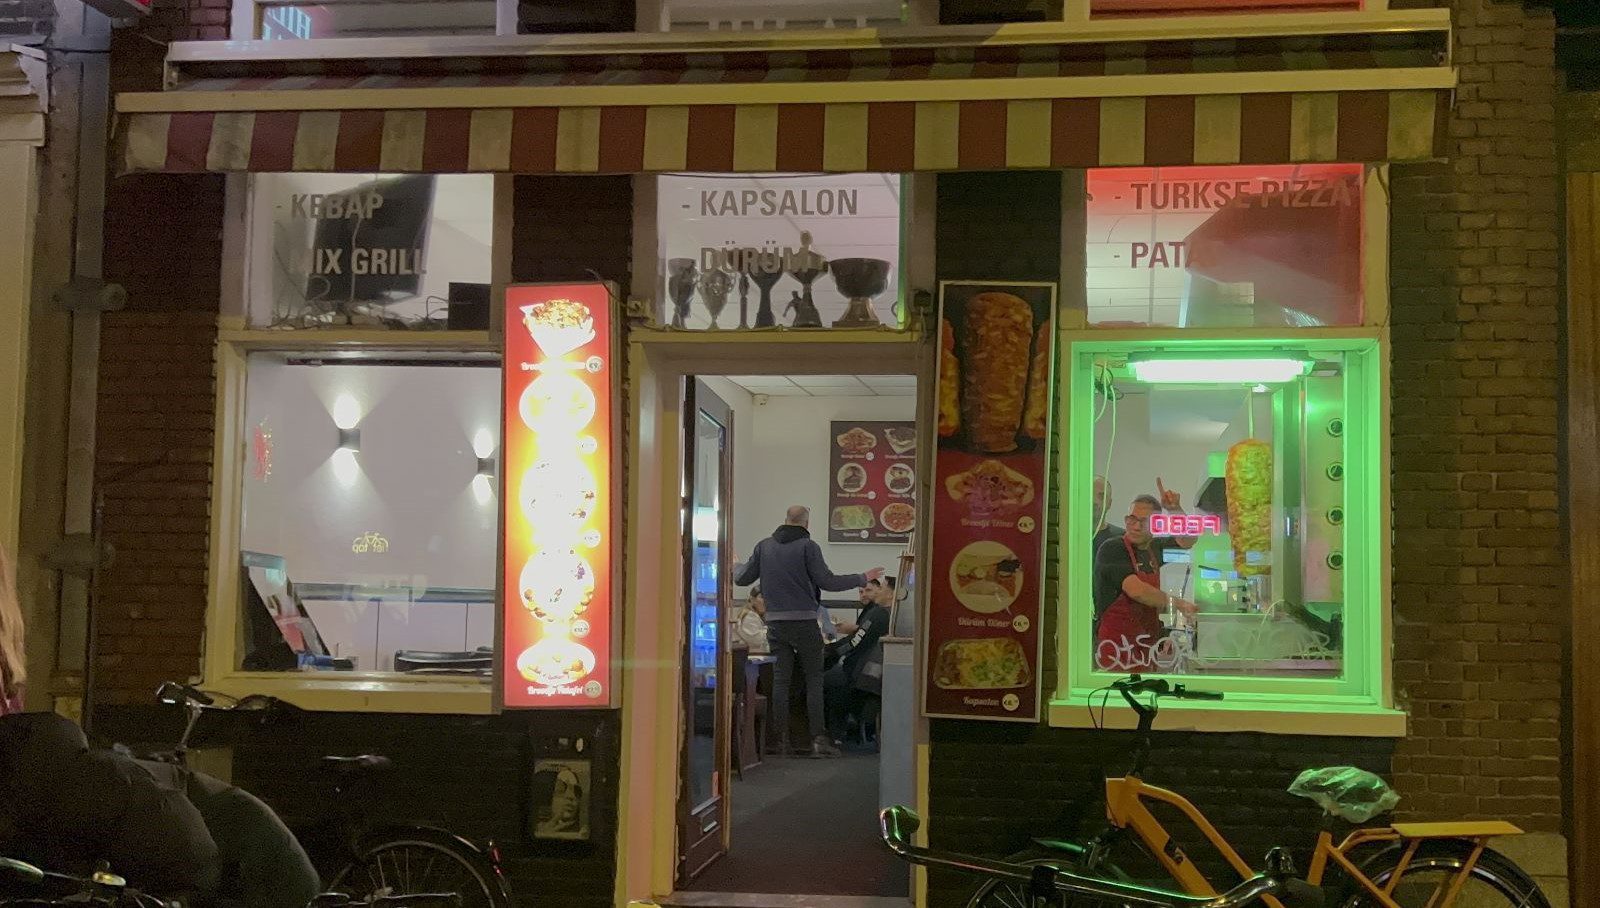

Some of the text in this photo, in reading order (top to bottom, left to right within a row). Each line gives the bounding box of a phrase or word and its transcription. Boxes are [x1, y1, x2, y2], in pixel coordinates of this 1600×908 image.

[291, 193, 384, 219] KEBAP
[701, 189, 858, 216] KAPSALON
[1130, 180, 1250, 210] TURKSE
[1261, 179, 1352, 208] PIZZA
[351, 247, 427, 275] GRILL
[700, 240, 810, 274] DÜRÜM
